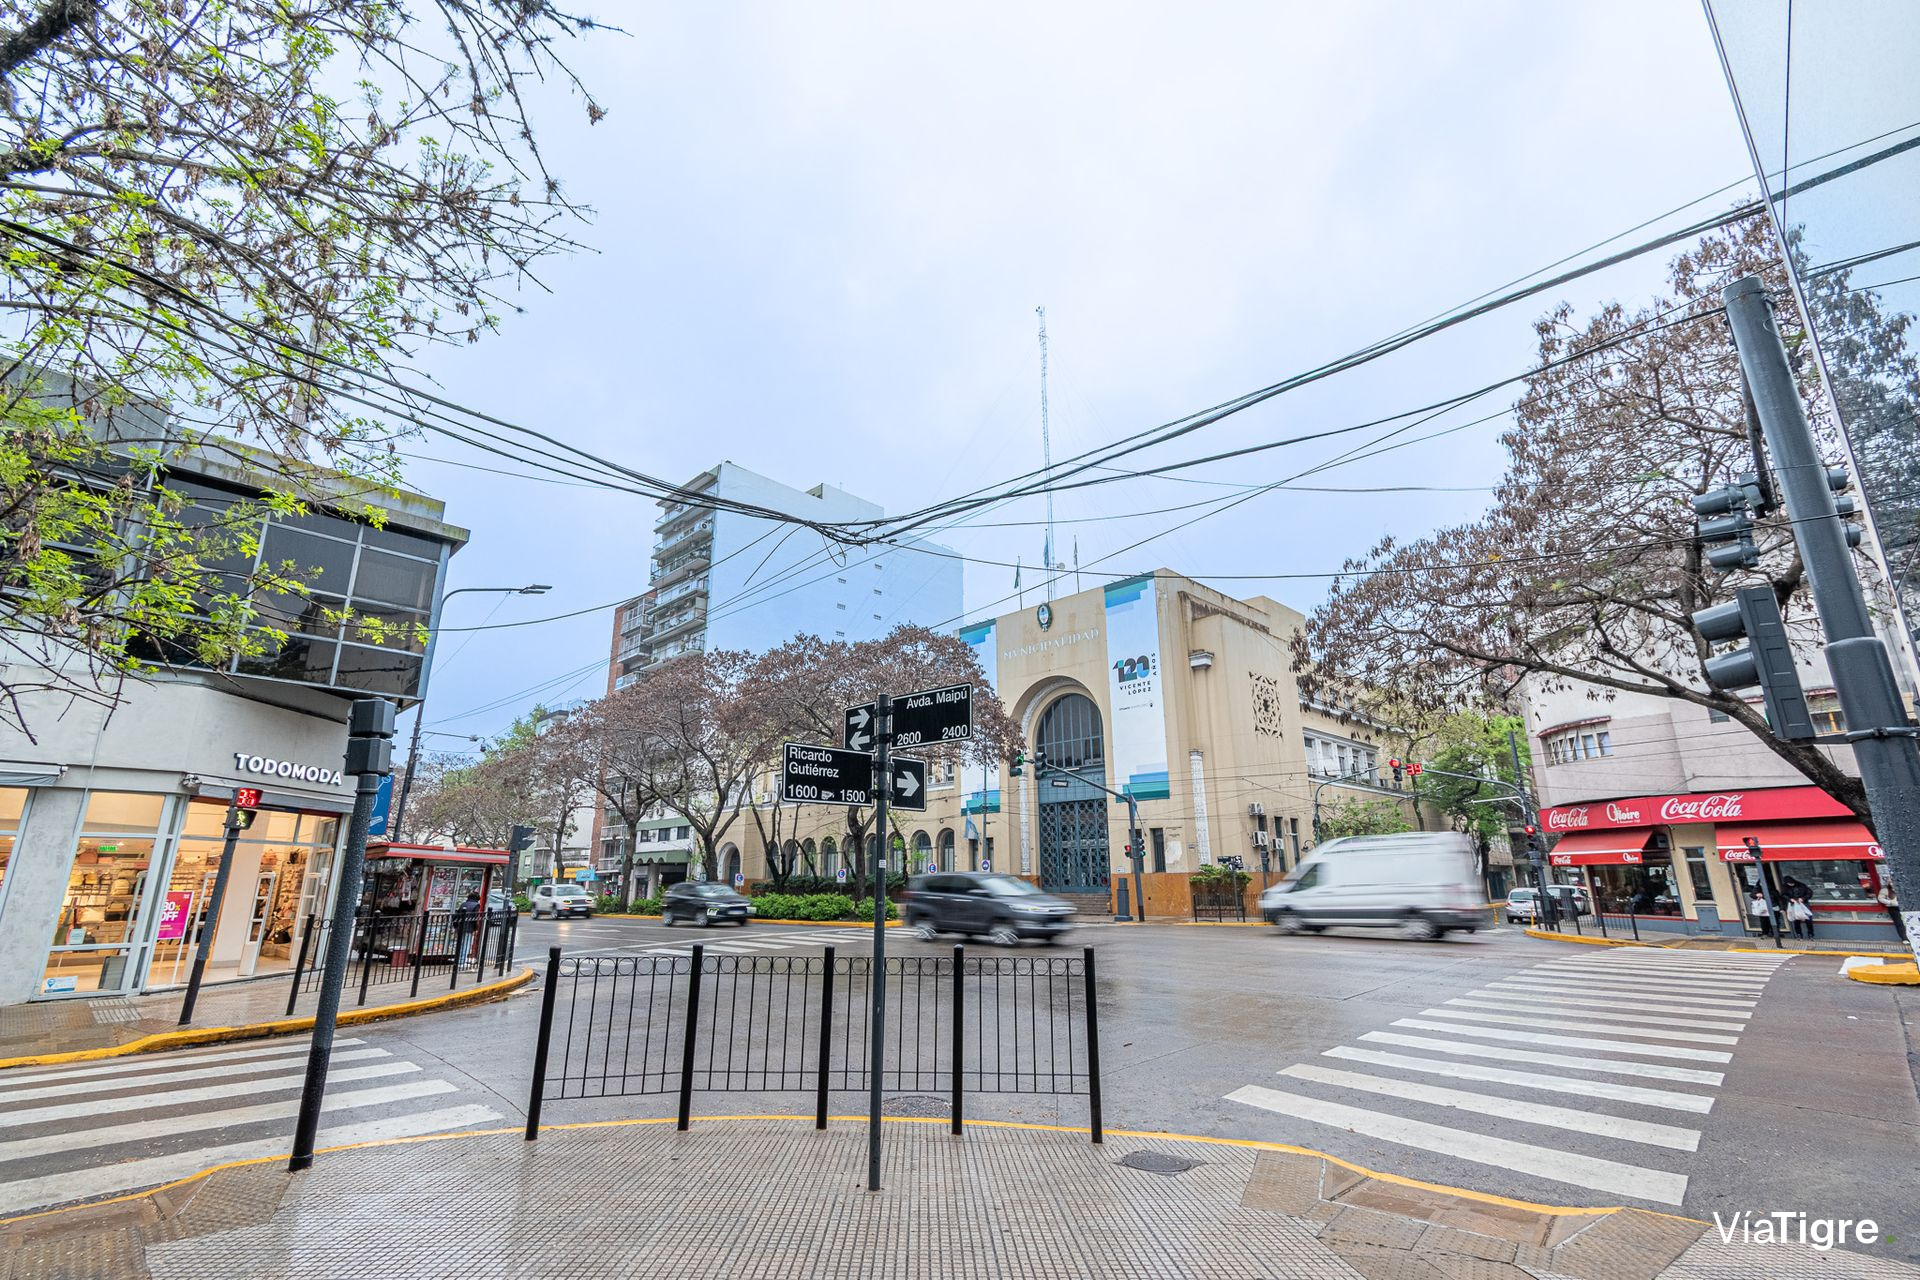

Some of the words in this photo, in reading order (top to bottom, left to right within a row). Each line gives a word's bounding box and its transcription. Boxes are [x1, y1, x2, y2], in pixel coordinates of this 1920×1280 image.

[1113, 655, 1150, 683] 120
[1120, 681, 1151, 690] VICENTE
[906, 694, 933, 709] Avda.
[936, 688, 967, 705] Maipú
[897, 731, 921, 746] 2600
[942, 724, 968, 739] 2400
[789, 747, 832, 763] Ricardo
[236, 753, 342, 786] TODOMODA
[789, 761, 839, 778] Gutiérrez
[1406, 764, 1423, 775] 39
[788, 785, 818, 799] 1600
[840, 789, 866, 803] 1500
[1661, 794, 1743, 820] Coca-Cola
[1548, 807, 1588, 829] Coca-Cola
